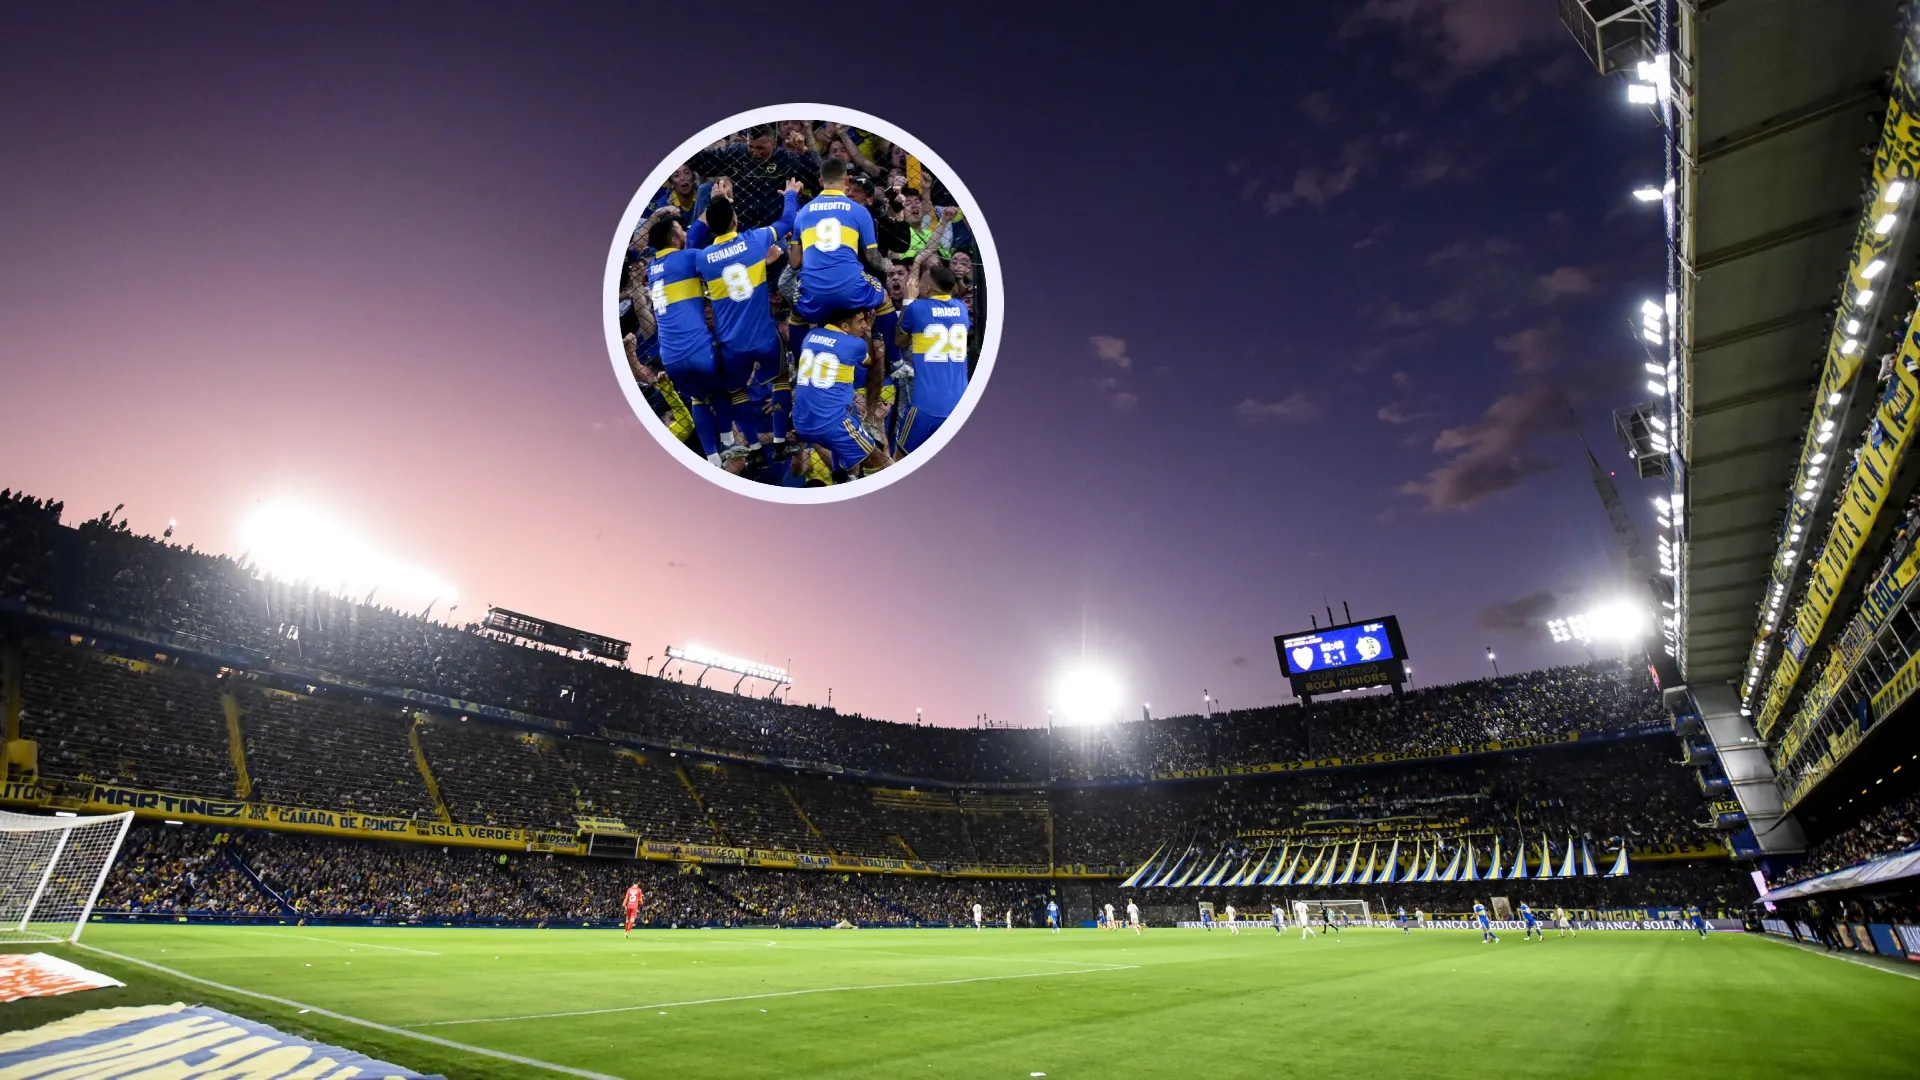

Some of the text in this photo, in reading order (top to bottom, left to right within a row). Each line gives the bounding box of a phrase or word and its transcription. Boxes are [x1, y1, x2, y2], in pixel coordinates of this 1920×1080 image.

[809, 201, 851, 212] BENEDETTO
[815, 217, 842, 251] 9
[706, 242, 748, 264] FERNANDEZ
[722, 262, 754, 302] 8
[651, 279, 668, 315] 4
[932, 306, 961, 318] BRIASCO
[808, 333, 836, 347] RAMIREZ
[923, 323, 968, 362] 29
[796, 349, 840, 389] 20
[1815, 576, 1835, 606] 12
[1826, 511, 1862, 578] TODOS
[1305, 672, 1388, 691] BOCA JUNIORS
[1310, 665, 1379, 681] CLUB ATLETICO
[1183, 763, 1271, 779] NUMERO
[1280, 762, 1304, 771] 12
[1314, 758, 1334, 768] LA
[1341, 754, 1375, 766] MAS
[1382, 745, 1452, 762] GRANDE
[1459, 743, 1497, 755] DEL
[1500, 732, 1571, 750] MUNDO
[93, 786, 247, 817] MARTINEZ
[1715, 801, 1741, 812] LIZA
[340, 817, 358, 828] DE
[362, 817, 408, 832] GOMEZ
[431, 824, 464, 837] ISLA
[468, 827, 512, 841] VERDE
[537, 833, 573, 843] HUDSON
[800, 855, 831, 865] TALAR
[1426, 920, 1469, 930] BANCO
[1597, 920, 1639, 931] BANCA
